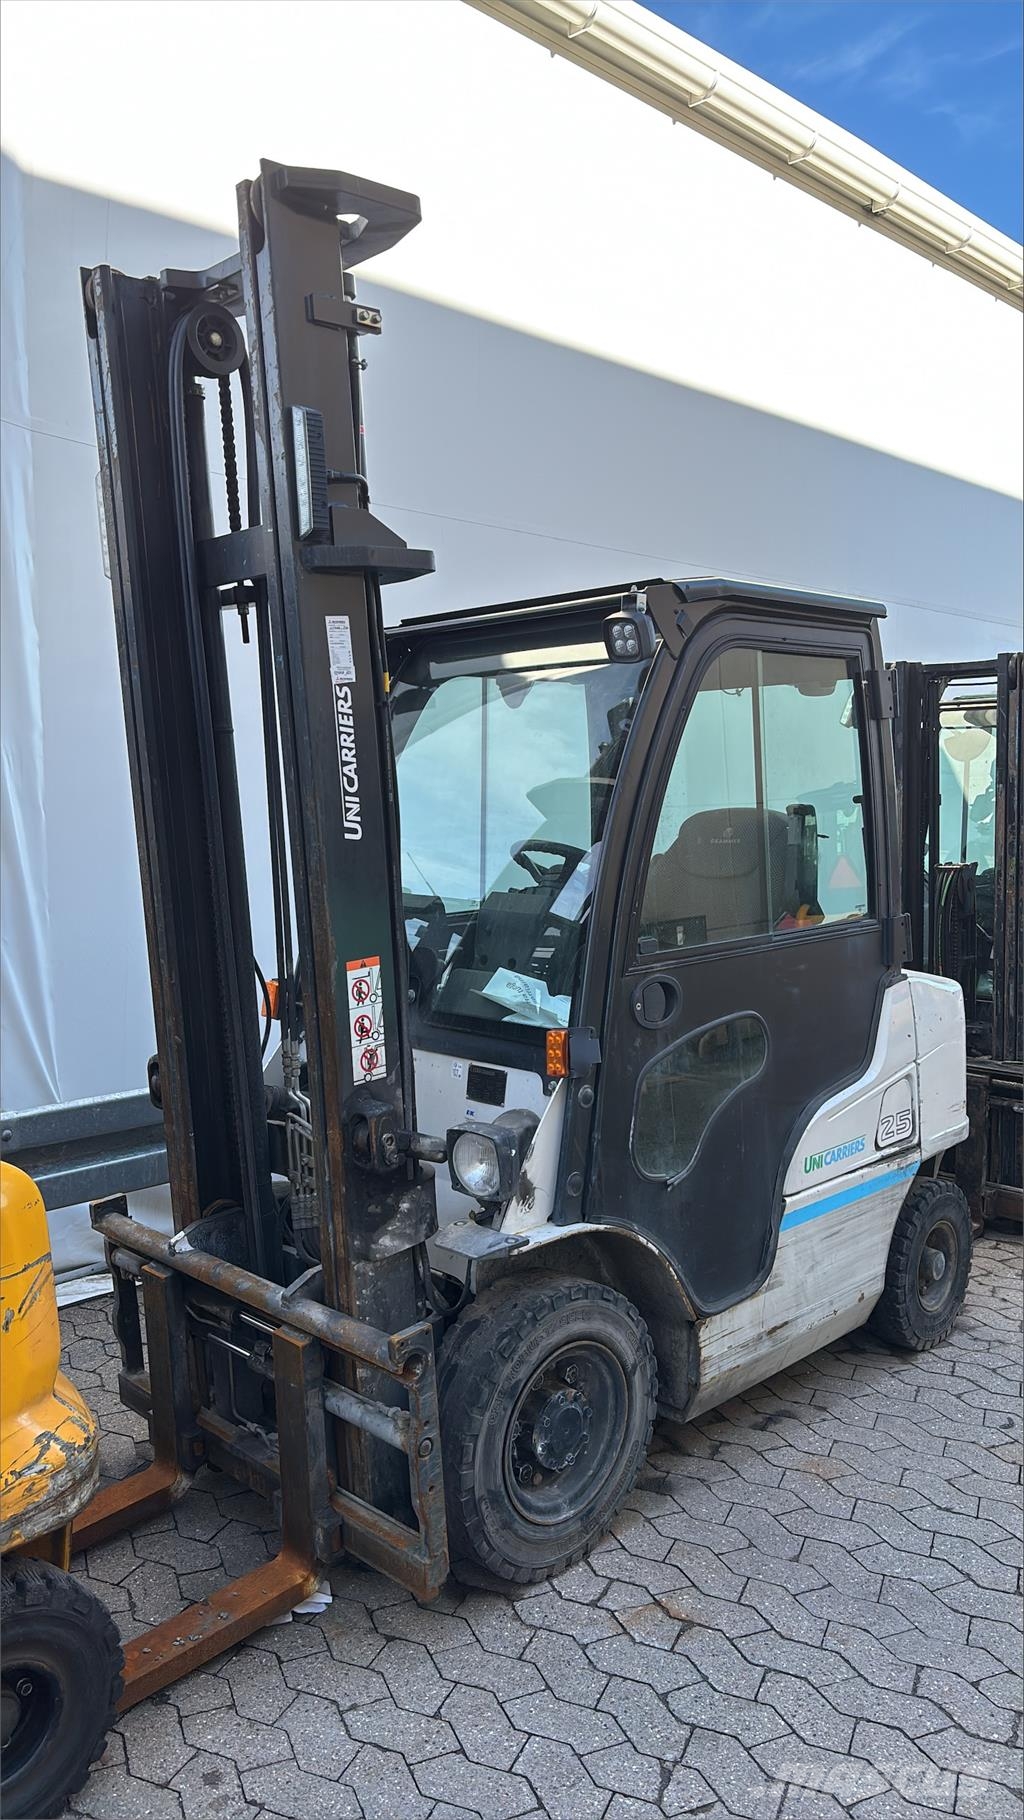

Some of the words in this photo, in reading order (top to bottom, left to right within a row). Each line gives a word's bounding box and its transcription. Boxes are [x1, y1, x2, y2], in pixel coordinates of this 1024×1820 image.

[335, 685, 363, 841] UNICARRIERS
[880, 1109, 912, 1142] 25
[804, 1137, 866, 1174] UNICARRIERS
